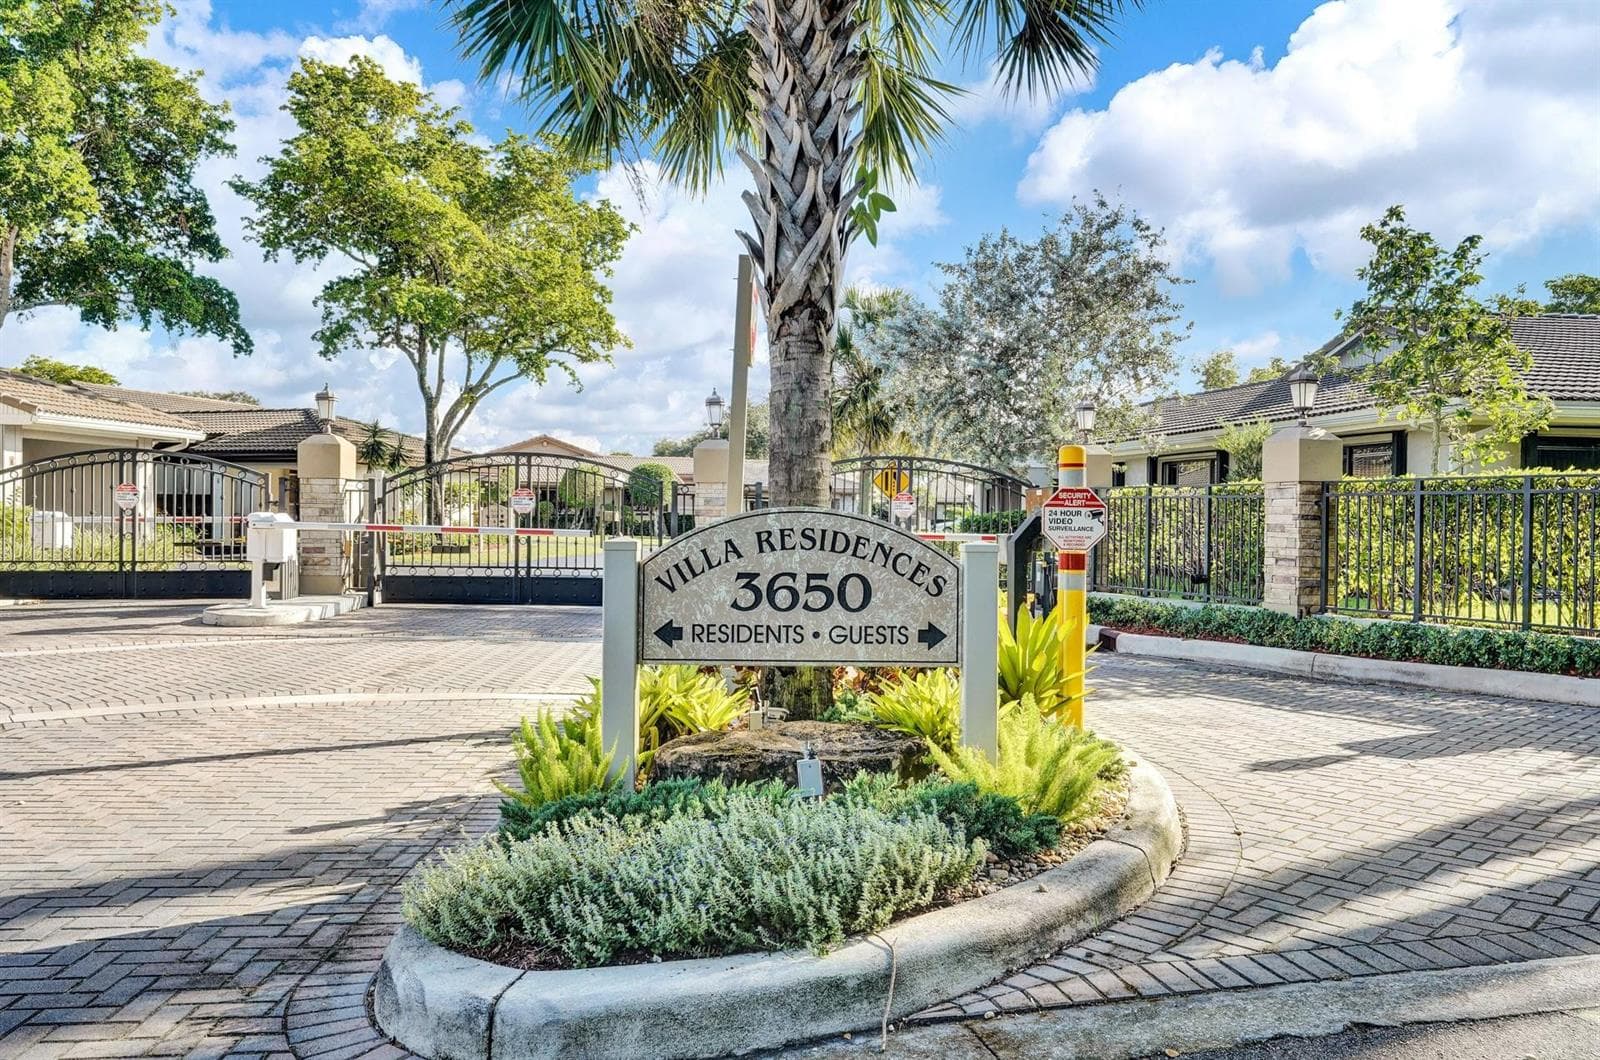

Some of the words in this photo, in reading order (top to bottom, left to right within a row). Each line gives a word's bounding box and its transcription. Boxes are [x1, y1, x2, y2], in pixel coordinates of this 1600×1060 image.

[654, 539, 744, 594] VILLA
[755, 527, 948, 598] RESIDENCES
[730, 572, 873, 613] 3650
[691, 624, 805, 645] RESIDENTS
[828, 625, 909, 645] GUESTS
